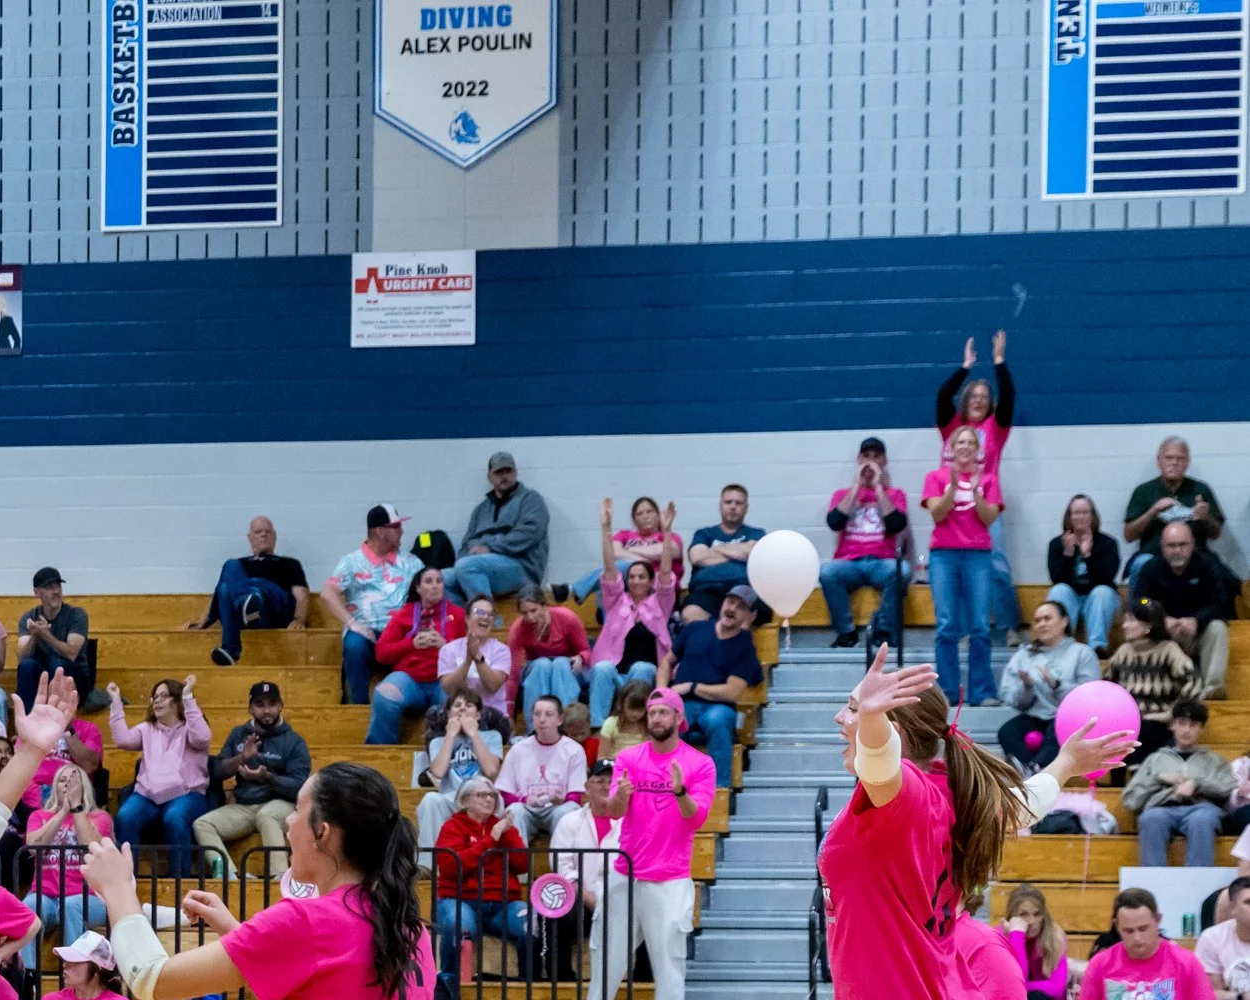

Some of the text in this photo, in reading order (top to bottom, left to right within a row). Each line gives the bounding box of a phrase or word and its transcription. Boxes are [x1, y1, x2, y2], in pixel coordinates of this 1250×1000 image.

[152, 3, 272, 23] ASSOCIATION 14
[420, 5, 513, 30] DIVING
[401, 32, 532, 55] ALEX POULIN
[442, 80, 489, 98] 2022
[385, 263, 448, 276] Pine Knob
[383, 277, 472, 291] URGENT CARE
